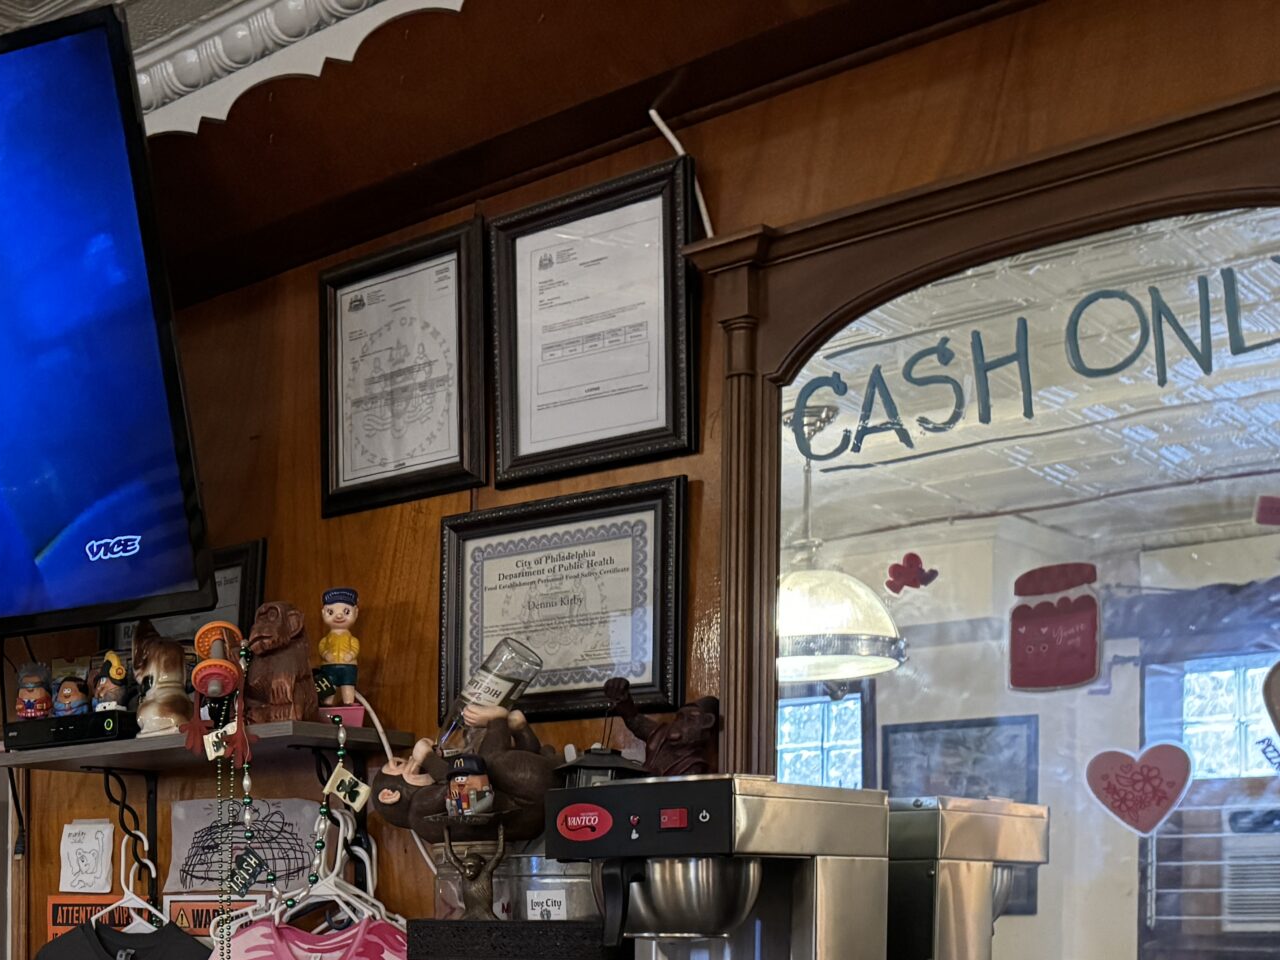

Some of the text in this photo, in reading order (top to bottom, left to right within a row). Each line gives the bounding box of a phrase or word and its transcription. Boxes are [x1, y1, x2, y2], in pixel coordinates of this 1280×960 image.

[792, 256, 1280, 462] CASH ONL
[85, 535, 141, 561] VICE
[515, 549, 596, 570] City of Philadelphia
[498, 556, 615, 582] Department of Public Health
[561, 814, 598, 832] AVANTCO
[229, 856, 260, 895] IRISH
[531, 897, 562, 911] Love City
